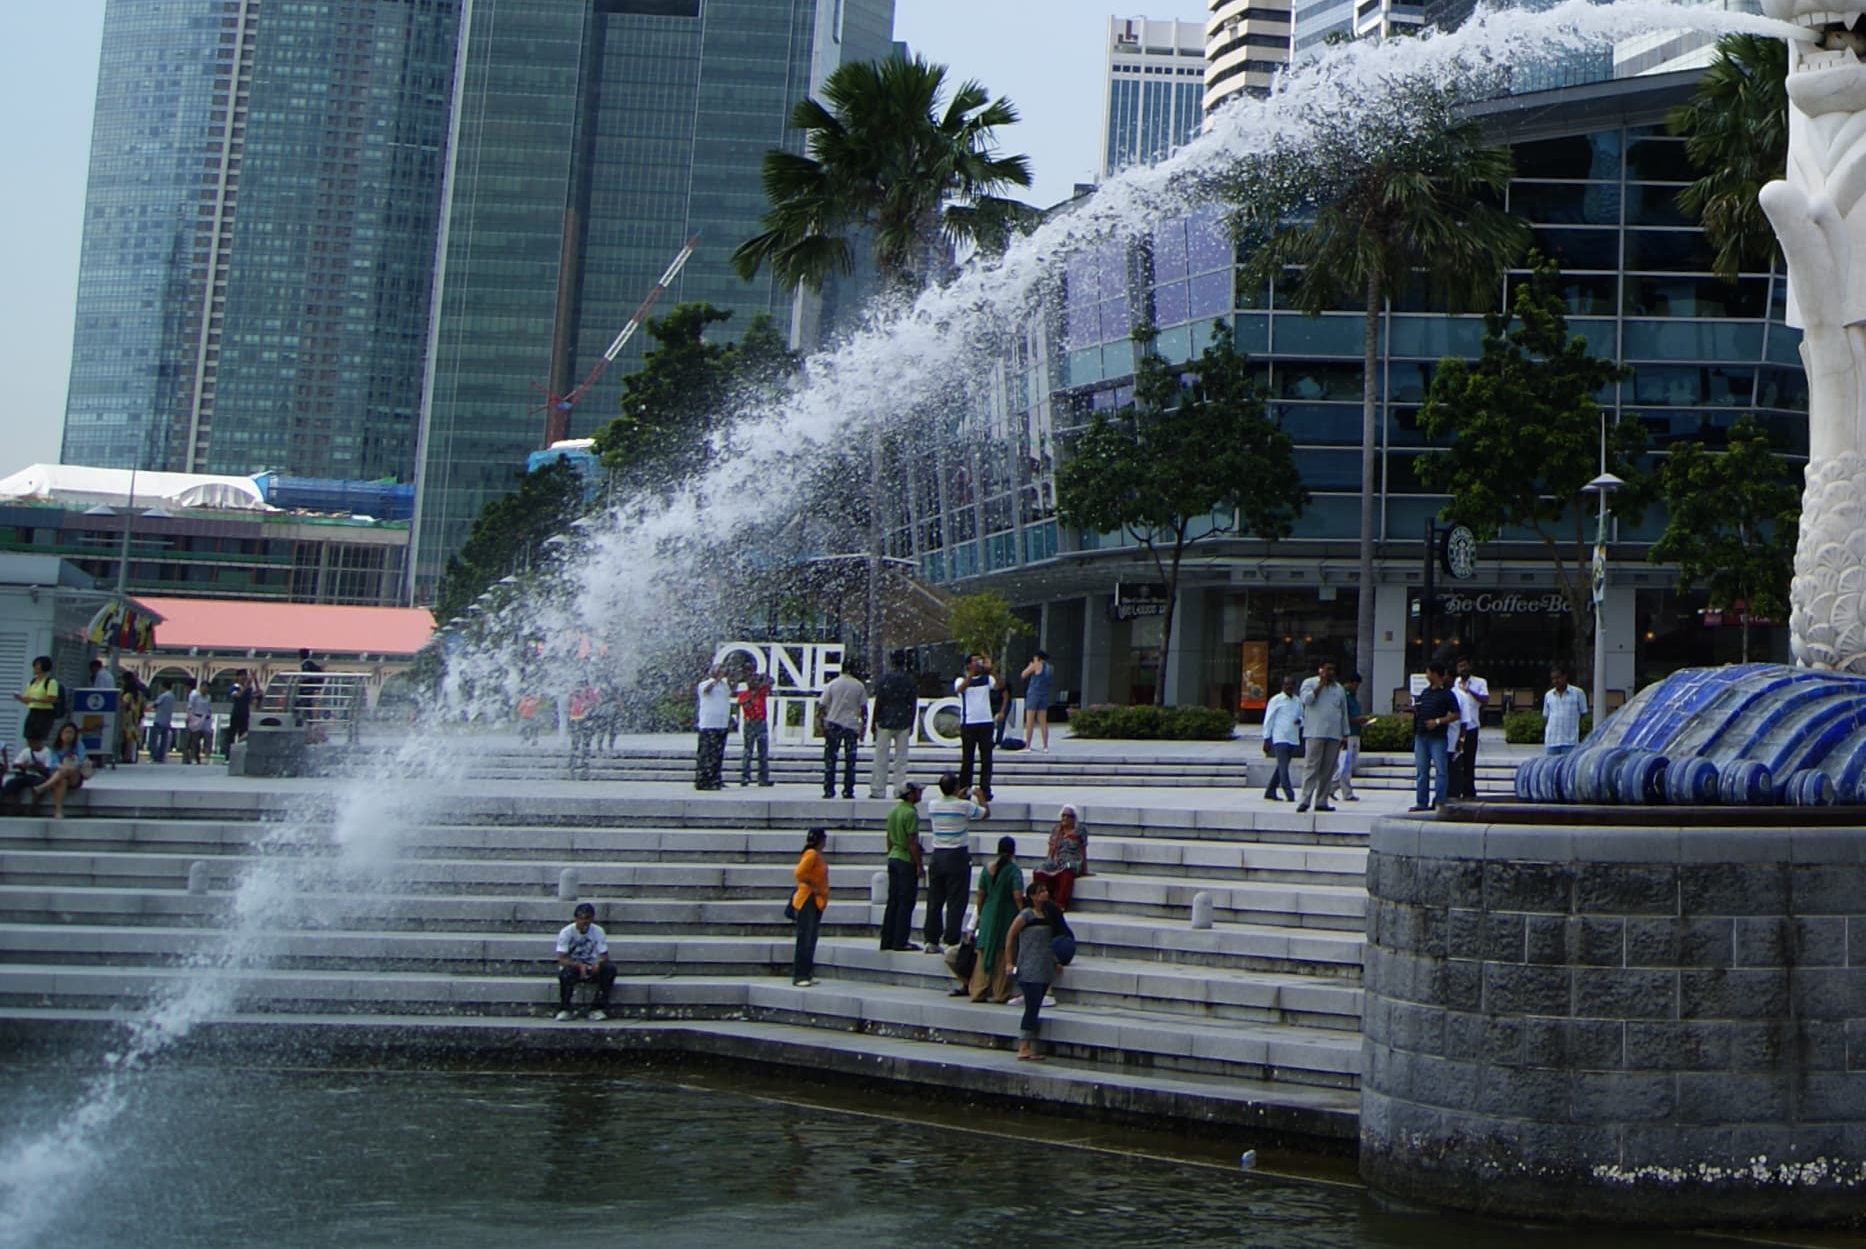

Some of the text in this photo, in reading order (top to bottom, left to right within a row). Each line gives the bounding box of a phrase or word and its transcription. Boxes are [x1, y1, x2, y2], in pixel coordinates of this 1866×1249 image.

[1439, 593, 1472, 614] The
[1475, 594, 1538, 613] Coffee
[713, 643, 846, 692] ONE
